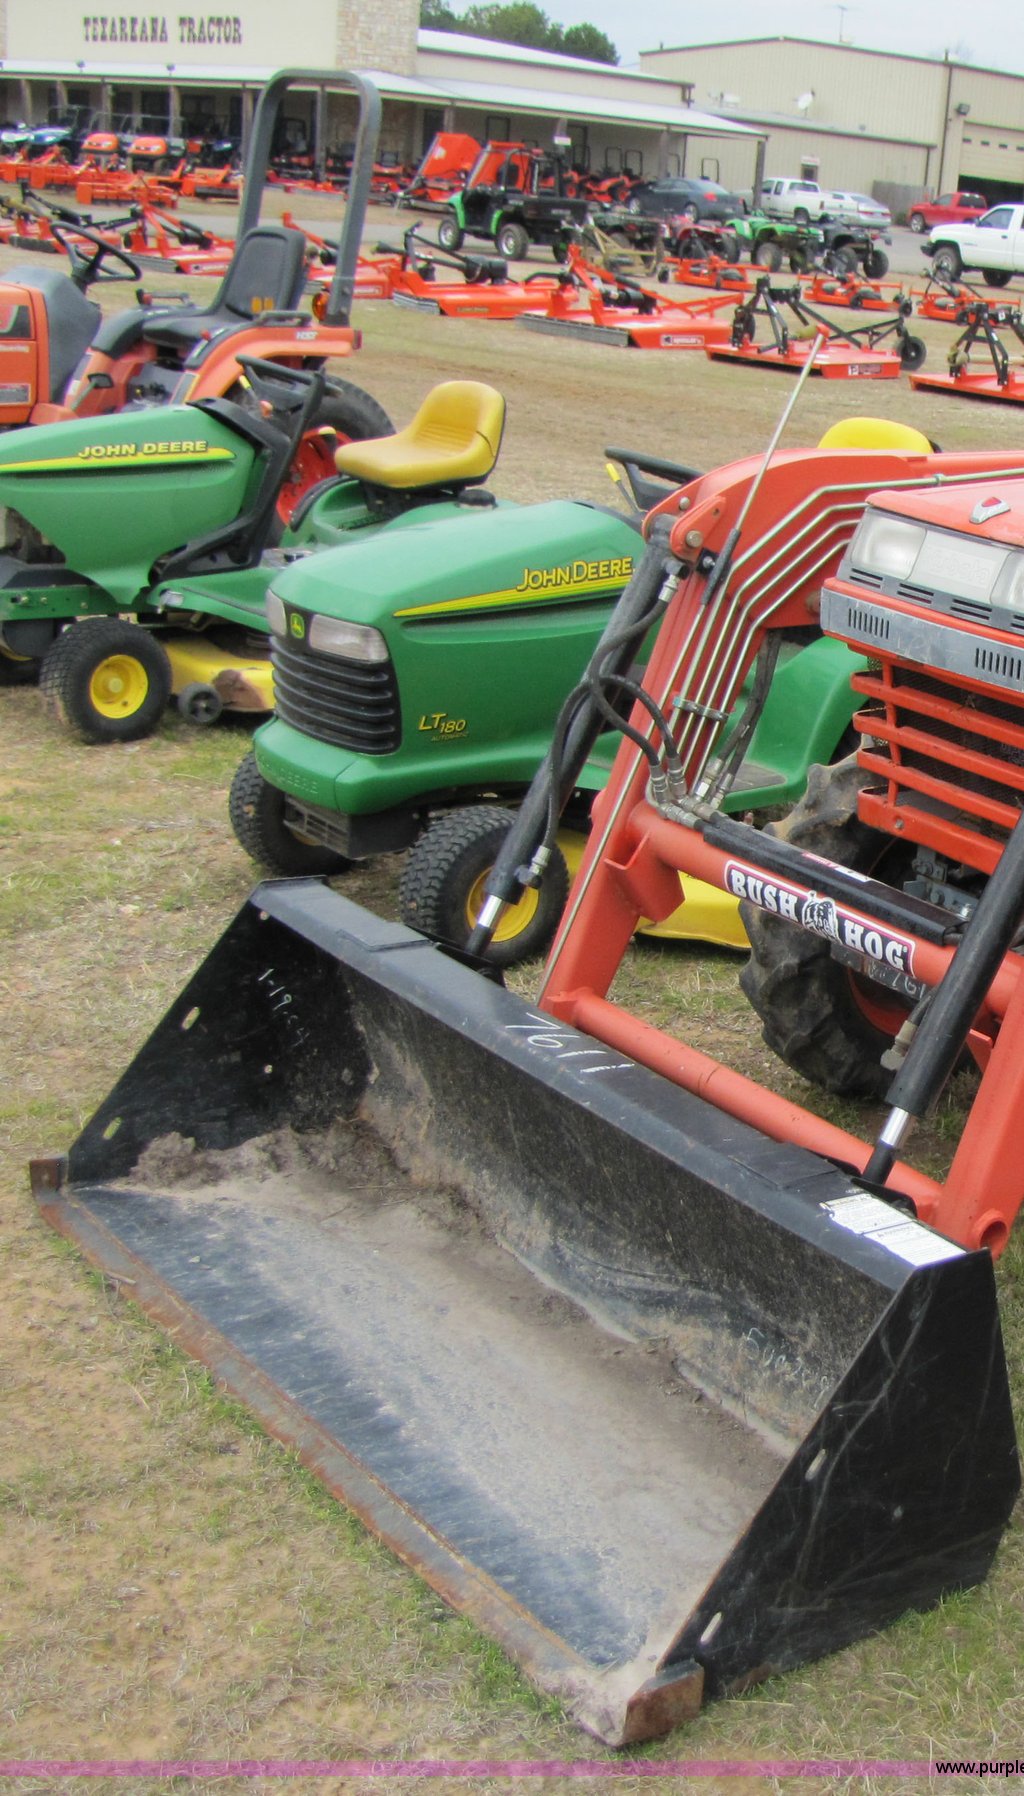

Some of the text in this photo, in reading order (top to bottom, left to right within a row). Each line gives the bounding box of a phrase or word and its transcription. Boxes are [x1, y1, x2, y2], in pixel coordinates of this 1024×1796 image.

[83, 16, 242, 44] TEXARKANA TRACTOR
[78, 440, 208, 459] JOHN DEERE
[516, 556, 633, 592] JOHN DEERE
[730, 869, 905, 972] BUSH HOG
